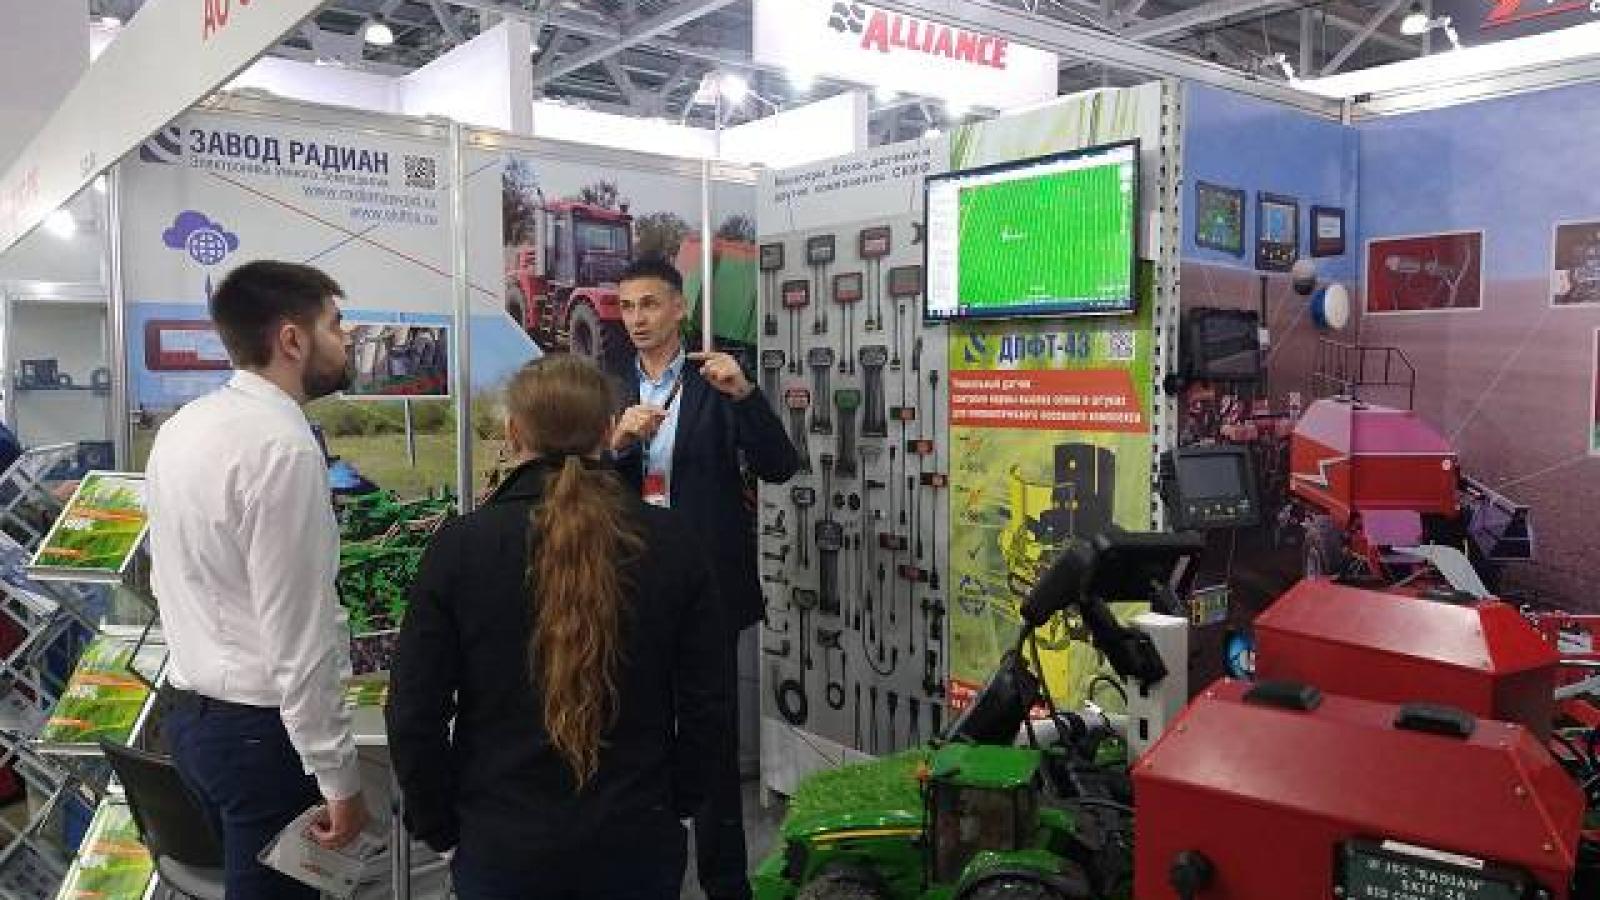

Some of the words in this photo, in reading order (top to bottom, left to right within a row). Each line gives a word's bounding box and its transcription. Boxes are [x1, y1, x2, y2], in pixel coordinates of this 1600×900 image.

[861, 9, 1008, 71] ALLIANCE
[189, 128, 281, 166] ЗАВОД
[289, 139, 389, 175] РАДИАН
